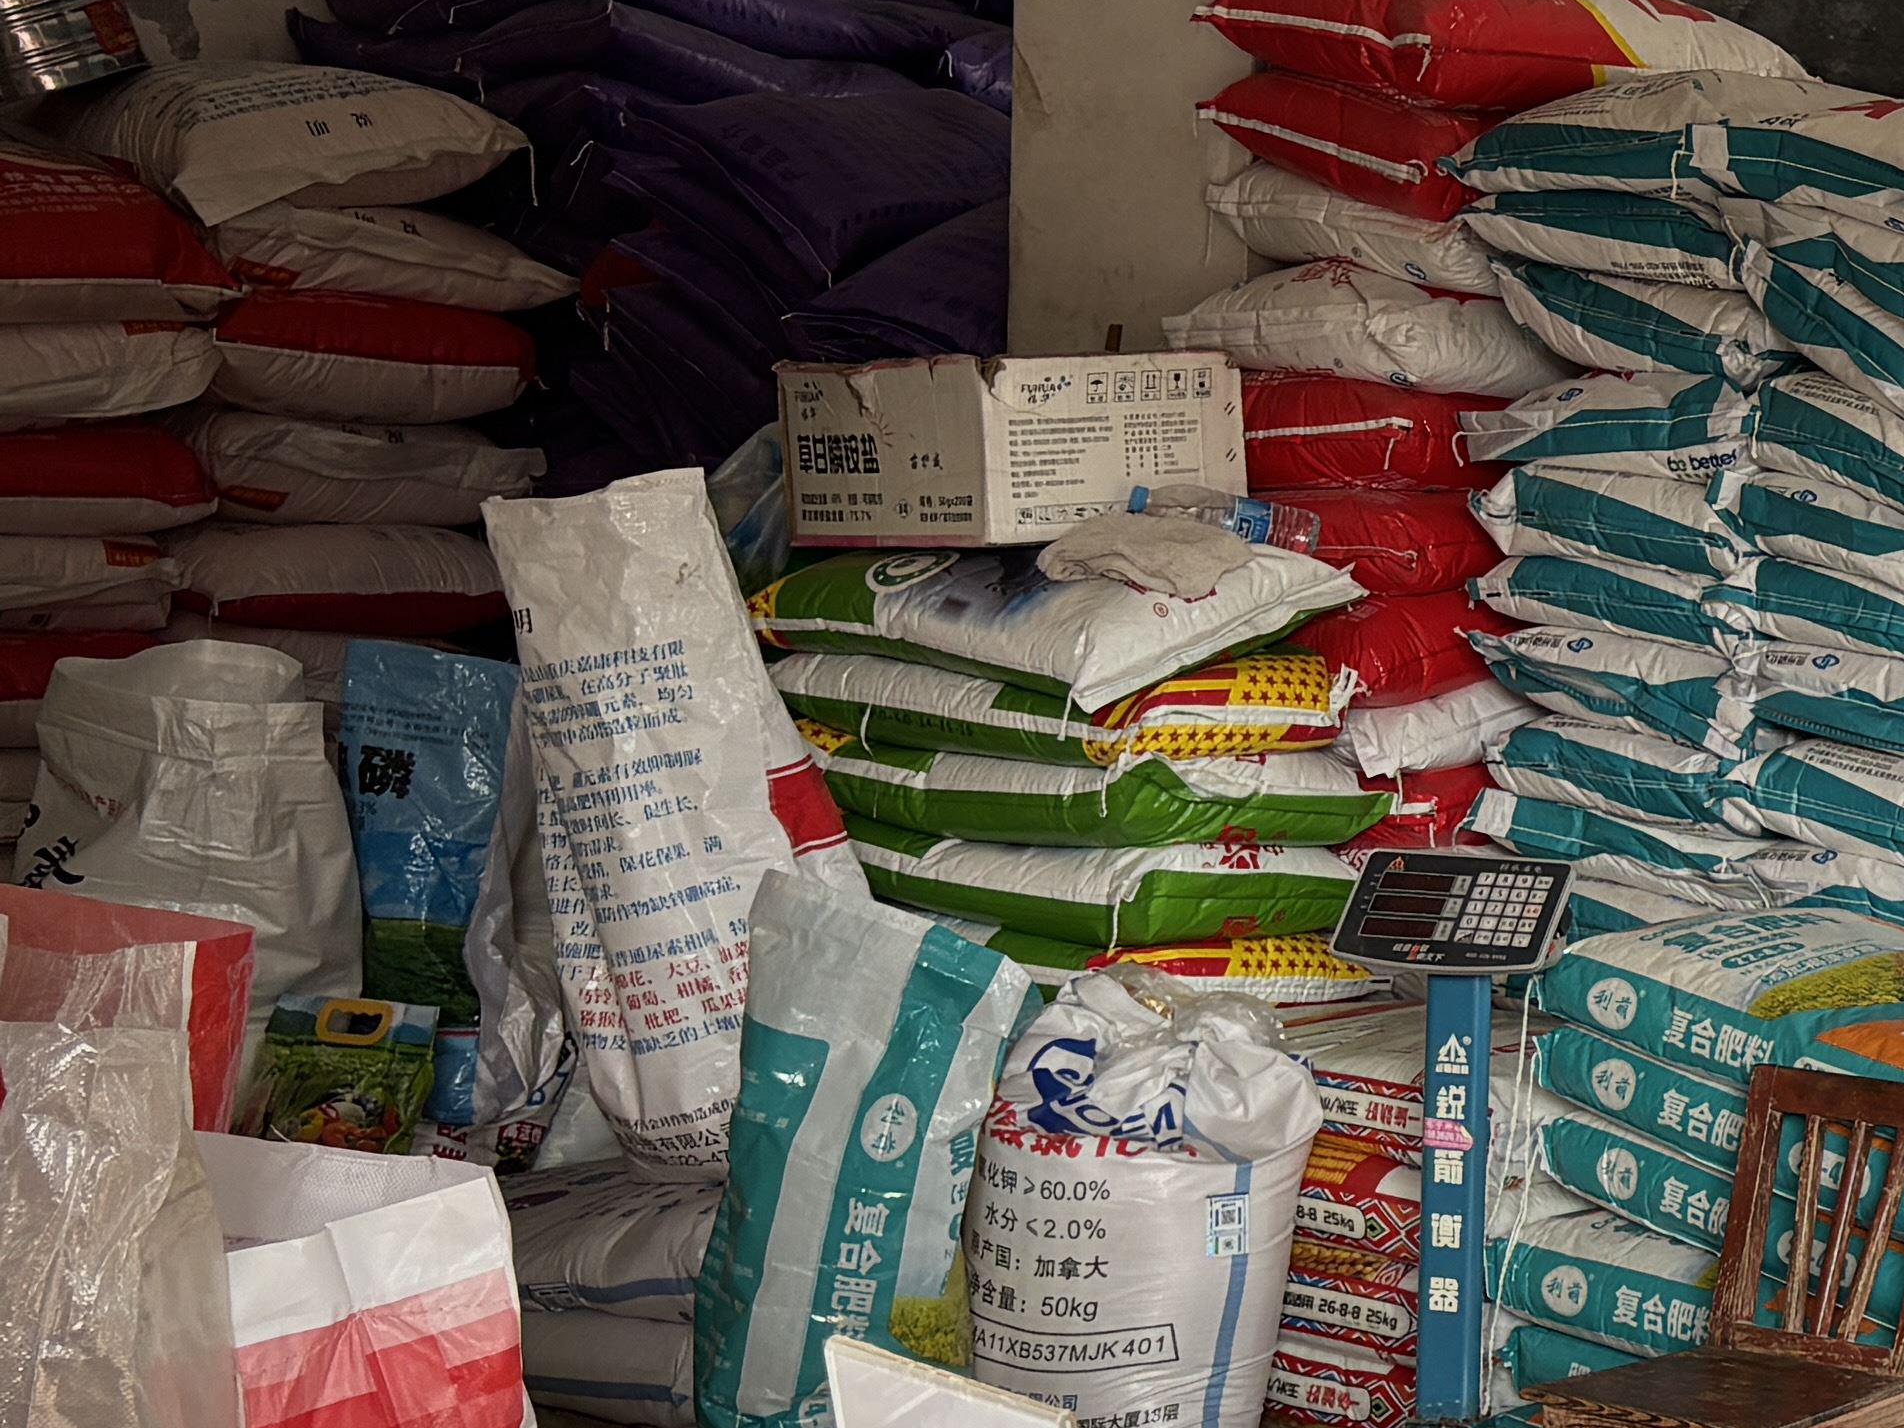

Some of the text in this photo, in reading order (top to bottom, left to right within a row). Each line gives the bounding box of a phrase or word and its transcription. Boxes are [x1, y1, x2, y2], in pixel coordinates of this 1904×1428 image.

[796, 433, 881, 475] 草甘膦铵盐
[1688, 447, 1737, 471] better
[1662, 1008, 1775, 1071] 复合肥料
[1323, 1211, 1355, 1233] 25kg
[1317, 1297, 1398, 1329] 26-8-8 25kg
